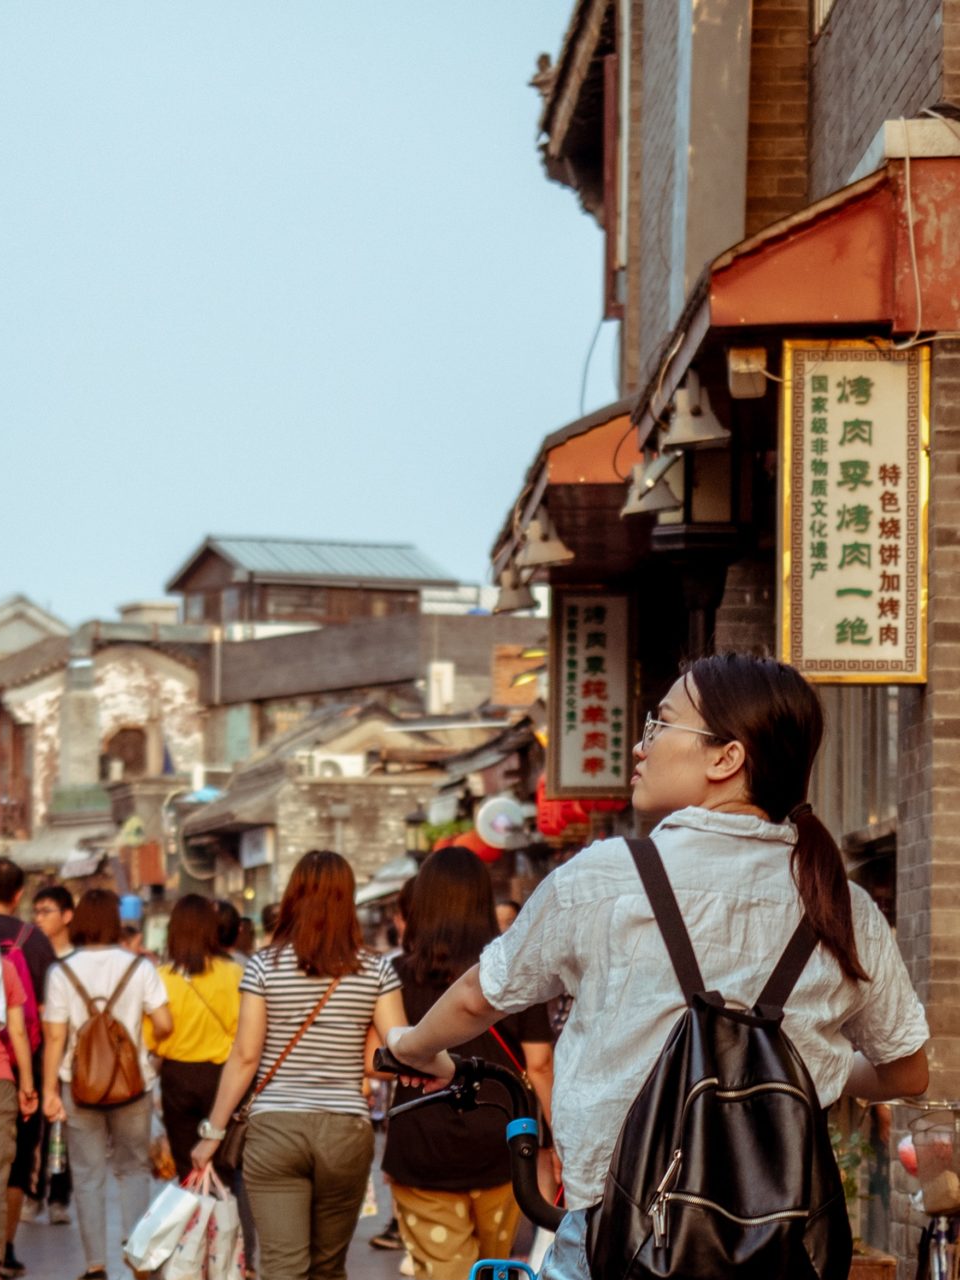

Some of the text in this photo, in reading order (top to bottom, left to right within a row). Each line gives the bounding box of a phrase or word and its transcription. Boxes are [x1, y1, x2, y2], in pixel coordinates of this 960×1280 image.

[810, 375, 829, 579] 国家级非物质文化遗产
[879, 464, 901, 646] 特色烧饼加烤肉
